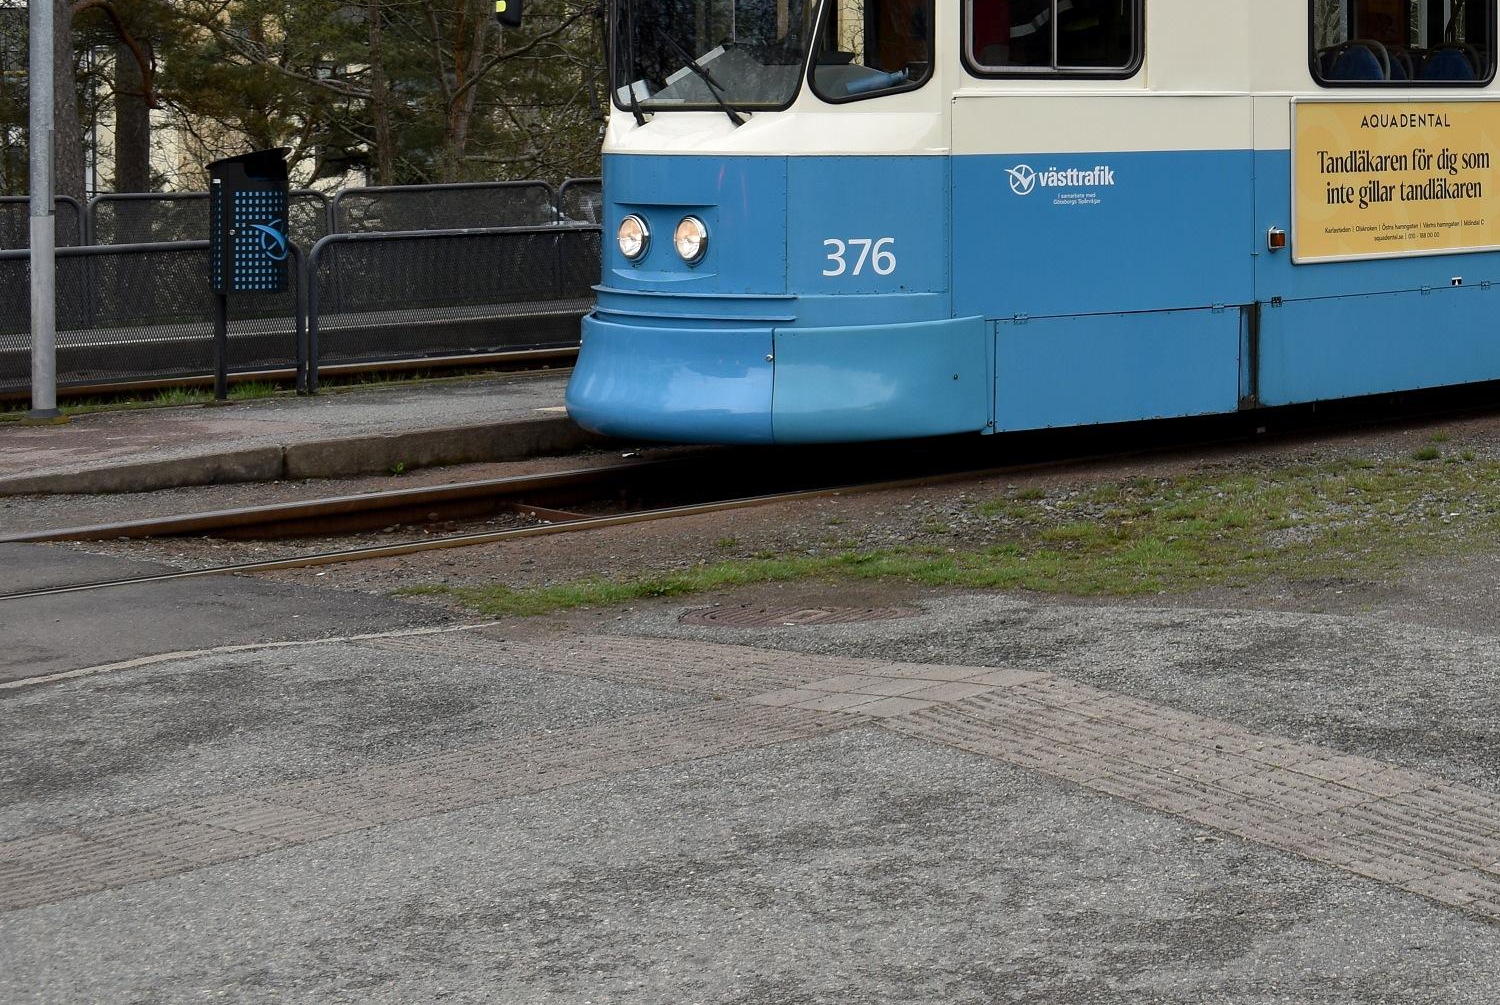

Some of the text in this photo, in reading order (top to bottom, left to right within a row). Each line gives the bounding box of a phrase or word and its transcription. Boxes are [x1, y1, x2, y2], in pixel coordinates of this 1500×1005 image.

[1360, 113, 1451, 128] AQUADENTAL
[1317, 148, 1490, 175] Tandläkaren för dig som
[1039, 166, 1115, 187] västtrafik
[1326, 178, 1482, 209] inte gillar tandläkaren
[822, 237, 897, 277] 376
